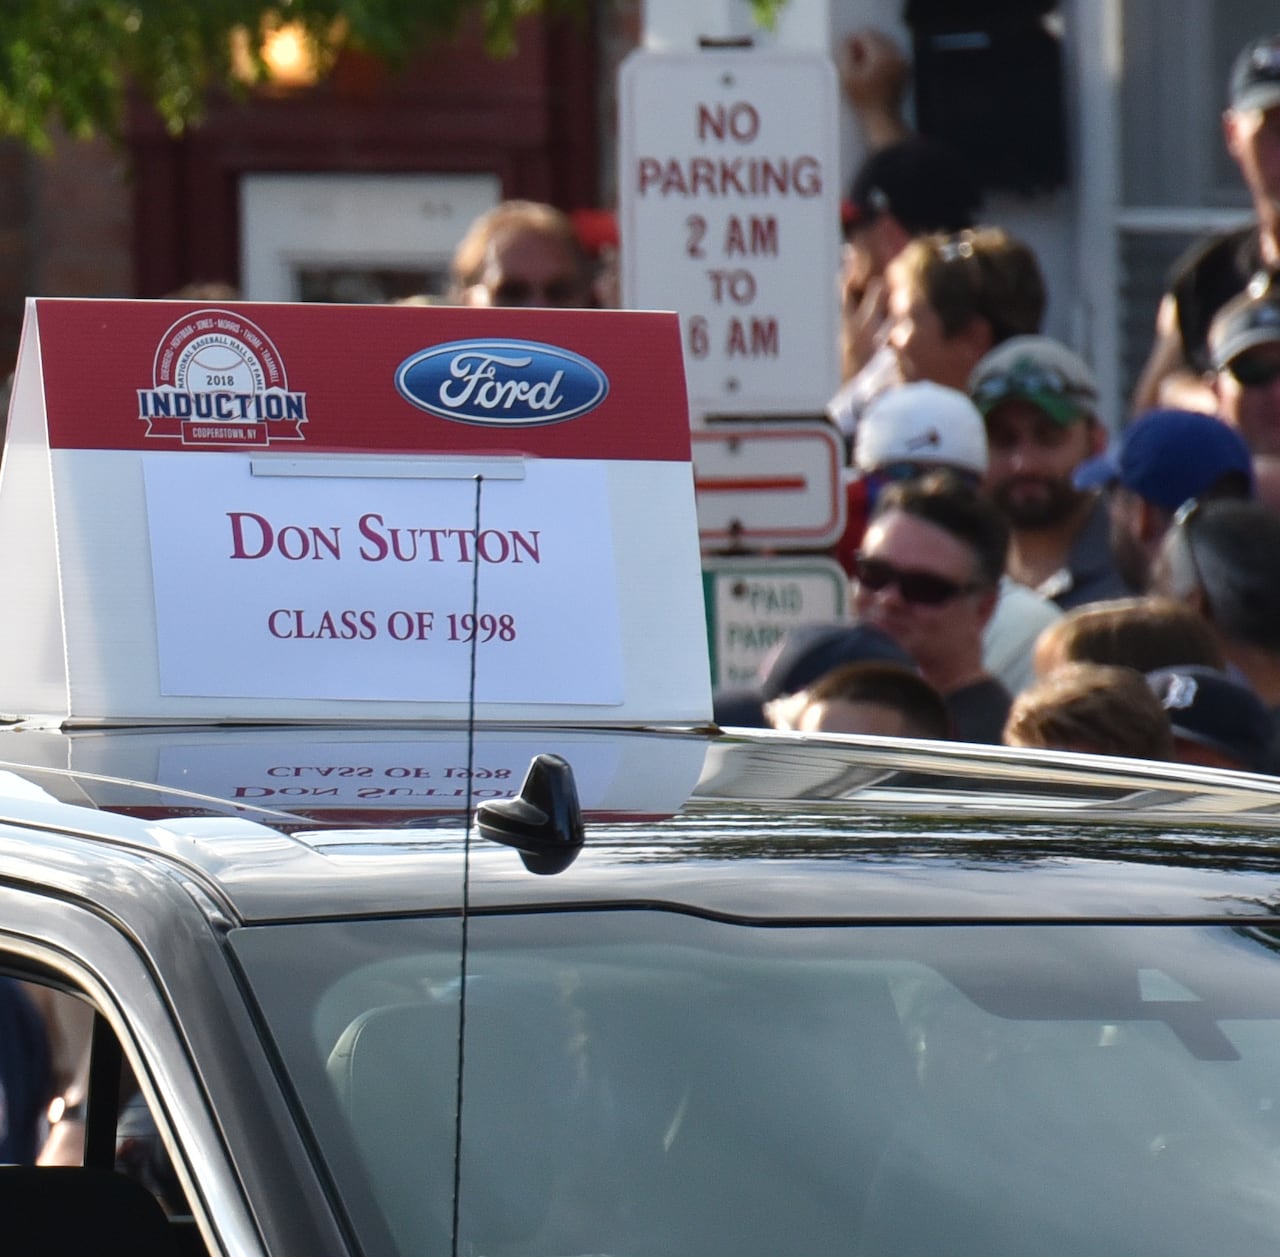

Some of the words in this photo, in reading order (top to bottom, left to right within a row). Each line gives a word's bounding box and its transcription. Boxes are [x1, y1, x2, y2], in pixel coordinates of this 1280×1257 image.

[697, 102, 761, 143] NO
[638, 156, 824, 198] PARKING
[686, 214, 707, 259] 2
[726, 214, 779, 257] AM
[707, 268, 757, 305] TO
[689, 315, 710, 360] 6
[726, 316, 779, 359] AM
[177, 350, 194, 390] NATIONAL
[192, 336, 228, 352] BASEBALL
[229, 340, 248, 358] HALL
[247, 356, 258, 367] OF
[253, 368, 264, 391] FAME
[206, 375, 235, 386] 2018
[439, 352, 565, 410] Ford
[139, 391, 306, 420] INDUCTION
[247, 429, 257, 439] NY
[226, 512, 341, 561] DON
[358, 513, 541, 564] SUTTON
[268, 609, 378, 641] CLASS
[387, 611, 434, 641] OF
[446, 613, 517, 643] 1998
